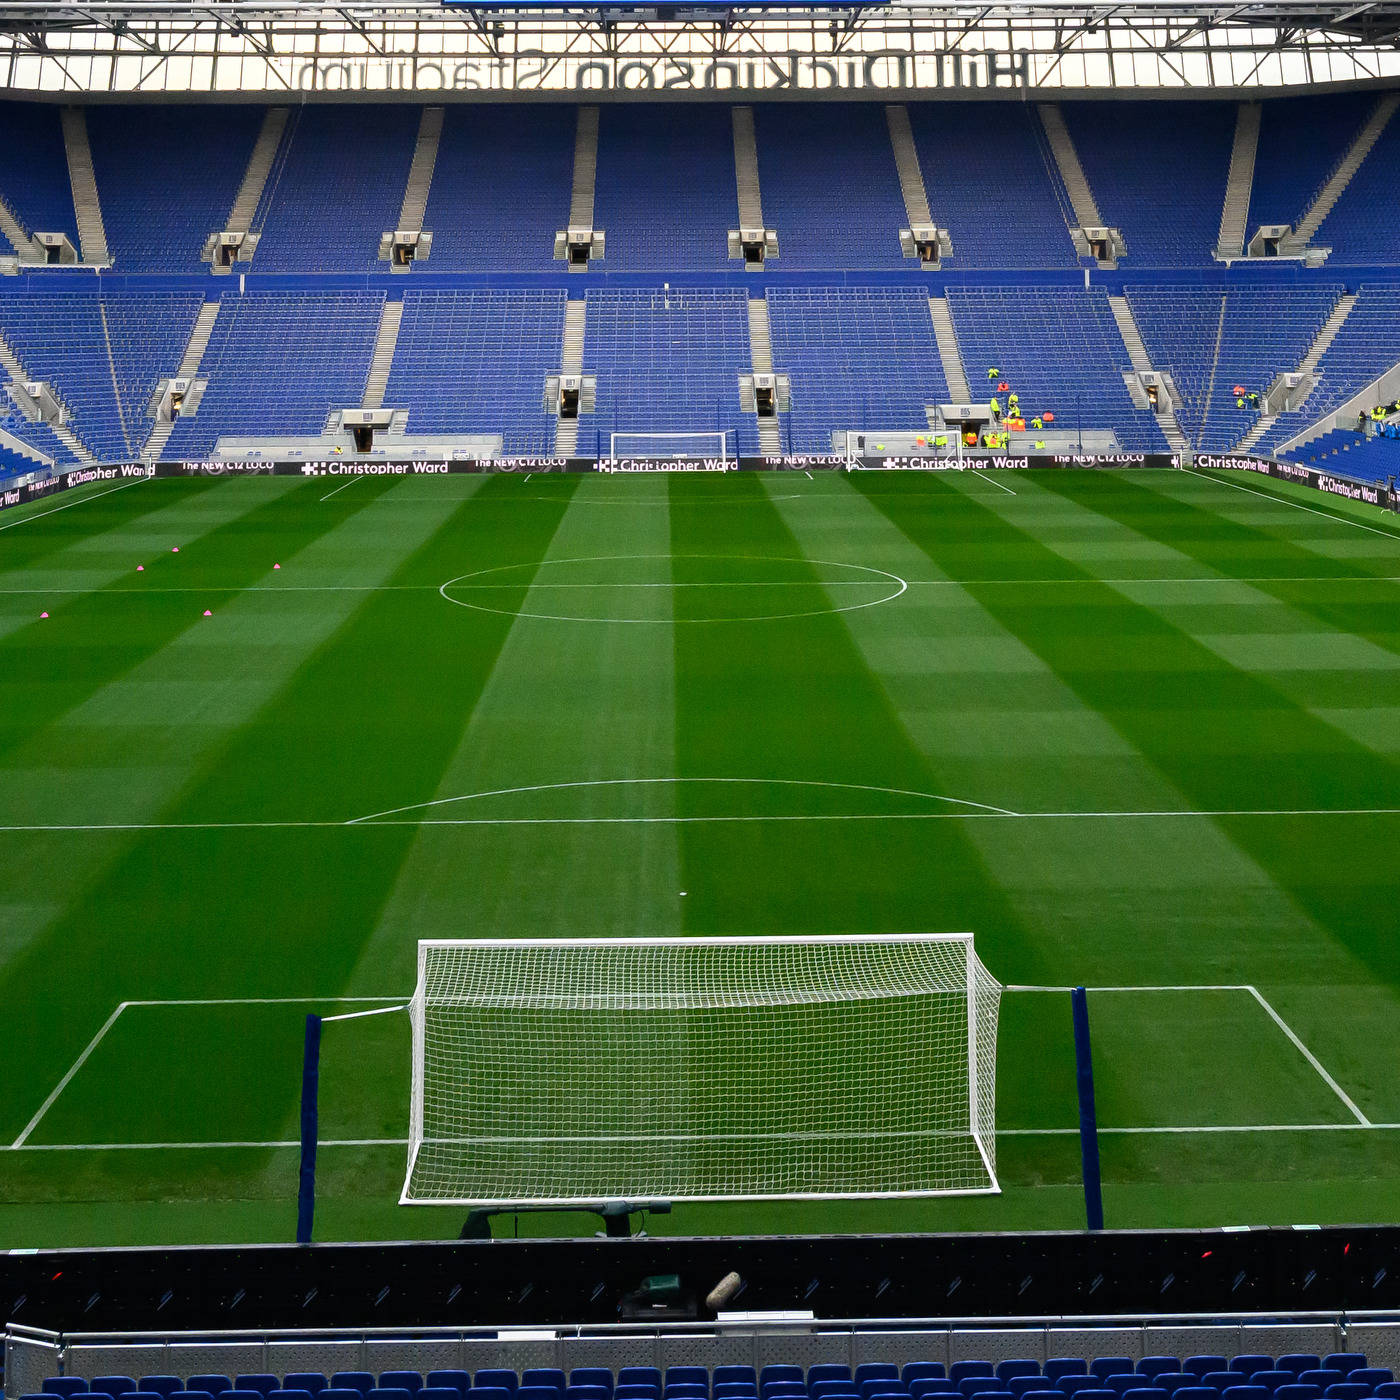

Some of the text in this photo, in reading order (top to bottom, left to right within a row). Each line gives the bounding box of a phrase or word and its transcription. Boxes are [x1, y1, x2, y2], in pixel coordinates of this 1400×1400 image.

[328, 461, 449, 475] Christopher Ward
[493, 459, 517, 467] NEW
[909, 456, 1029, 471] Christopher Ward
[1198, 455, 1257, 472] Christopher
[4, 488, 21, 505] Ward
[1361, 485, 1379, 504] Ward
